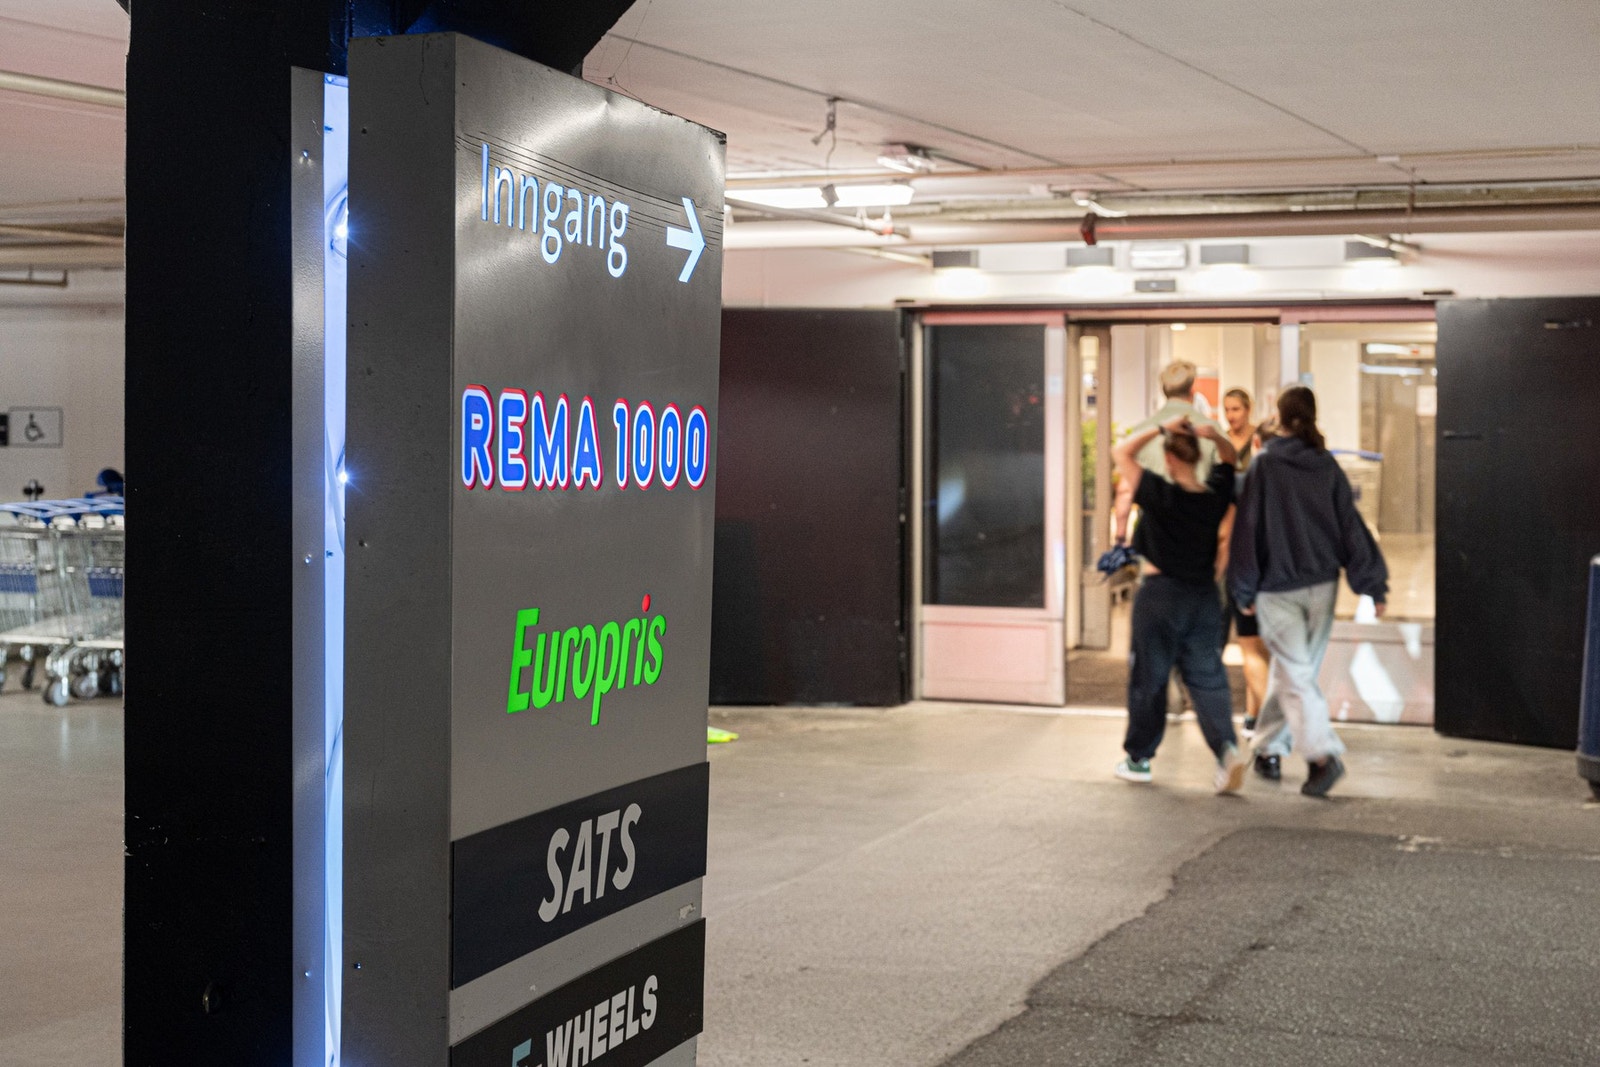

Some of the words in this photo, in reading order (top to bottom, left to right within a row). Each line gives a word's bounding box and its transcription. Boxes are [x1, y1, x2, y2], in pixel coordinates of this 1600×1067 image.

[481, 143, 630, 278] Inngang
[462, 384, 603, 491] REMA
[613, 398, 710, 491] 1000
[507, 593, 667, 726] Europris
[538, 803, 642, 923] SATS
[511, 974, 658, 1067] WHEELS
